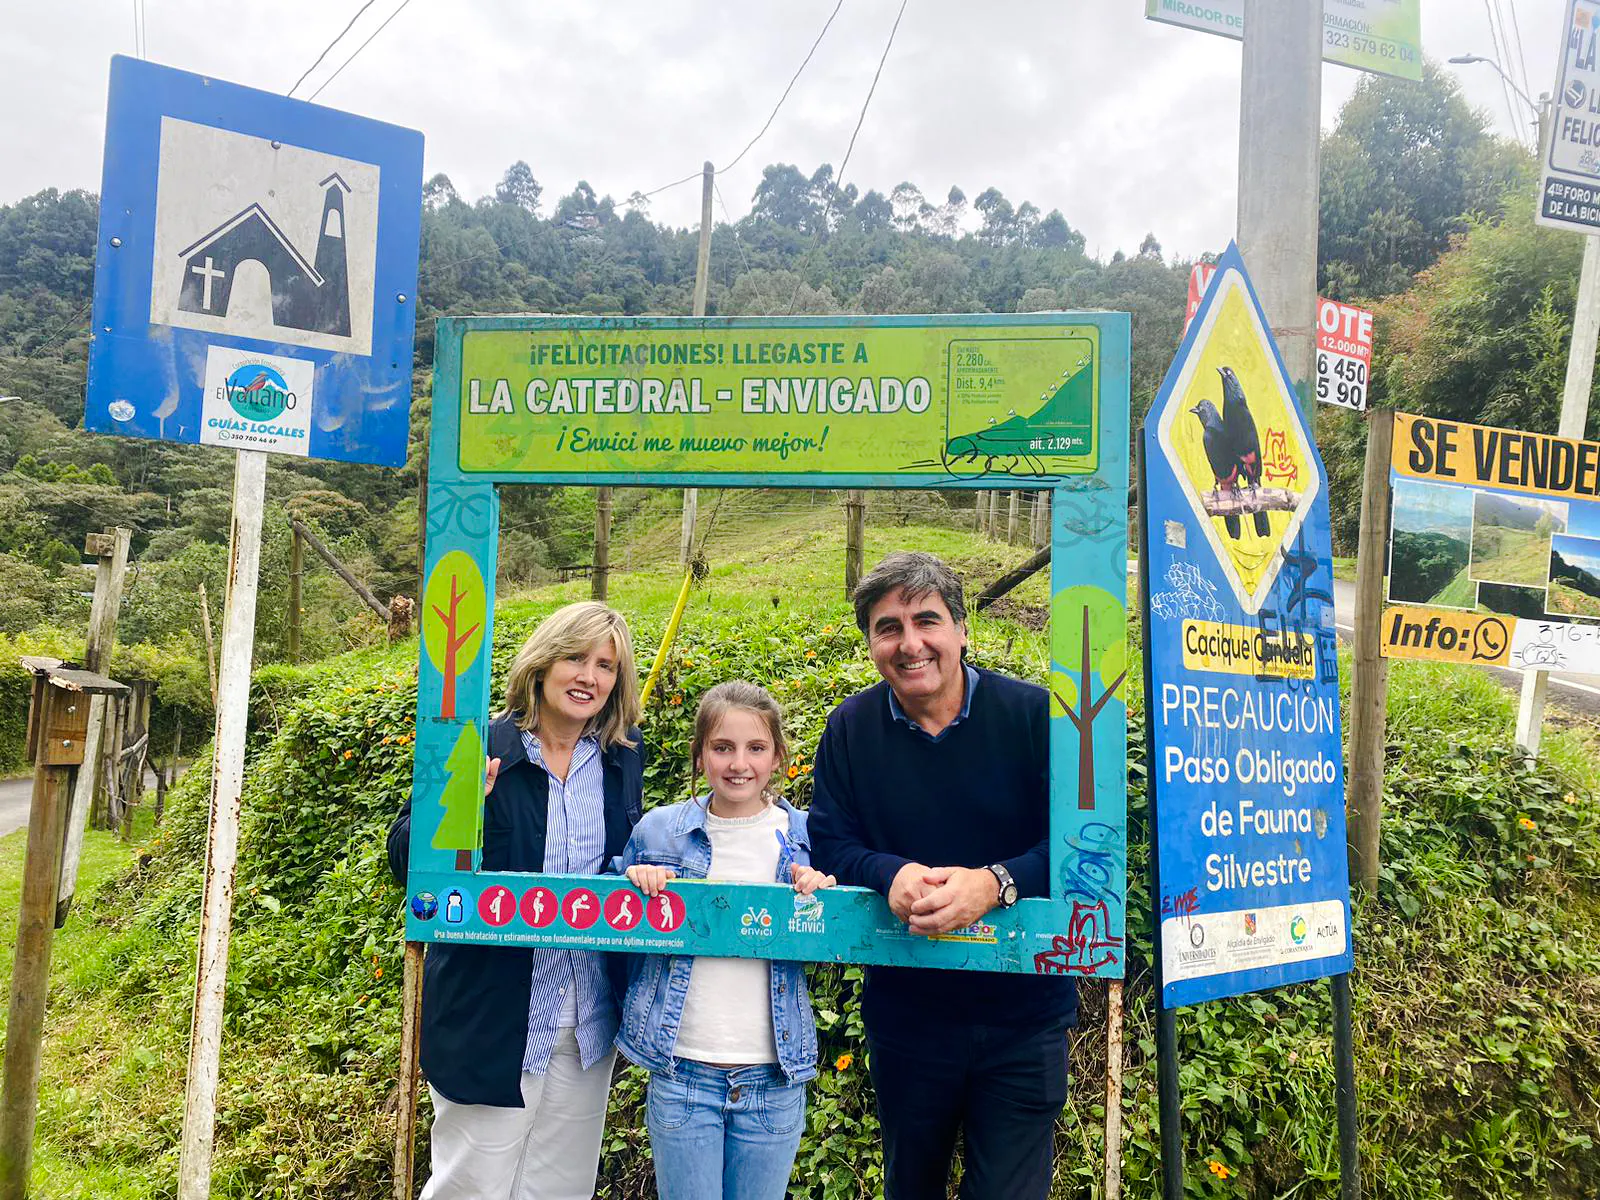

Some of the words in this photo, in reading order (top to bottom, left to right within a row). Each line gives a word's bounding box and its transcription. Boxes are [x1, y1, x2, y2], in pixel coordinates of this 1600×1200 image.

[1162, 0, 1222, 24] MIRADOR
[1326, 30, 1350, 49] 323
[1352, 36, 1377, 55] 579
[1380, 42, 1396, 59] 62
[1563, 186, 1591, 204] FORO
[1550, 201, 1564, 215] DE
[1565, 203, 1578, 218] LA
[1580, 206, 1600, 222] BICI
[1317, 302, 1373, 344] OTE
[530, 343, 724, 366] ¡FELICITACIONES!
[732, 342, 845, 365] LLEGASTE
[853, 342, 868, 363] A
[1317, 353, 1328, 375] 6
[1334, 358, 1365, 385] 450
[468, 378, 515, 414] LA
[525, 377, 712, 414] CATEDRAL
[742, 376, 932, 414] ENVIGADO
[957, 377, 977, 389] Dist.
[1317, 376, 1329, 399] 5
[1337, 381, 1361, 407] 90
[208, 417, 248, 432] GUÍAS
[250, 423, 305, 439] LOCALES
[643, 437, 675, 452] me
[680, 437, 749, 452] muevo
[752, 425, 830, 460] mejor!
[1048, 437, 1071, 450] 2.129
[1408, 419, 1458, 477] SE
[1186, 625, 1250, 665] Cacique
[1389, 613, 1470, 651] Info:
[1162, 683, 1334, 734] PRECAUCIÓN
[1165, 746, 1230, 784] Paso
[1235, 748, 1336, 797] Obligado
[1201, 801, 1233, 837] de
[1239, 800, 1313, 835] Fauna
[1205, 853, 1312, 892] Silvestre
[465, 930, 498, 941] hidratación
[504, 932, 541, 943] estiramiento
[553, 933, 596, 945] fundamentales
[645, 938, 685, 948] recuperación
[788, 917, 825, 934] #Envici
